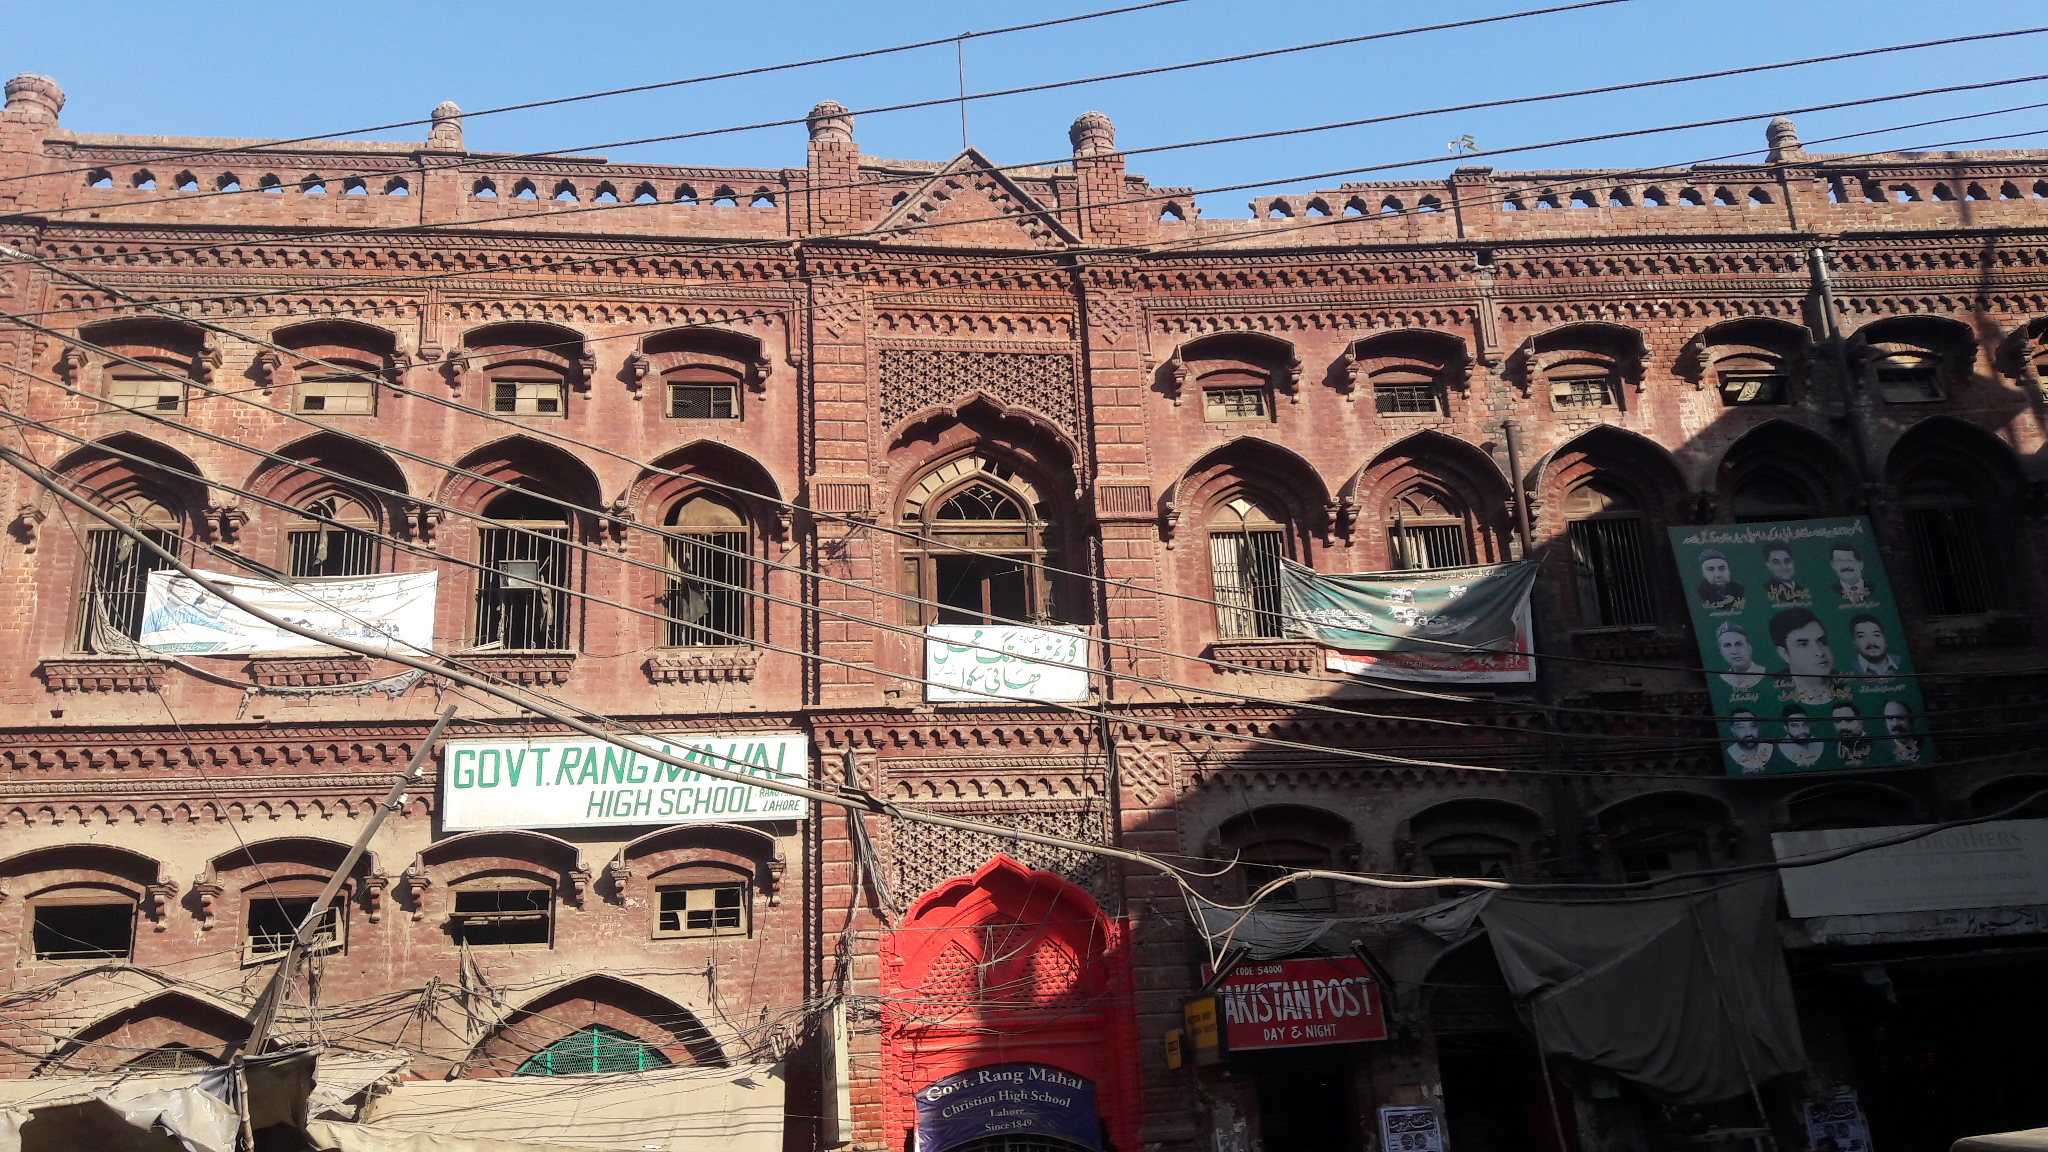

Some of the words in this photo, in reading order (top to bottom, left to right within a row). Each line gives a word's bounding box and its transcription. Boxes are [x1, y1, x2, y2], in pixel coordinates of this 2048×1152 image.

[454, 748, 551, 789] GOVT.
[554, 746, 649, 786] RANG
[653, 741, 794, 784] MAHAL
[586, 790, 651, 819] HIGH
[657, 784, 757, 816] SCHOOL
[762, 799, 802, 812] LAHORE
[1235, 967, 1254, 976] CODE
[1257, 964, 1283, 975] 54000
[1313, 976, 1373, 1020] POST
[1263, 1026, 1285, 1041] DAY
[1290, 1025, 1303, 1040] &
[1305, 1023, 1337, 1038] NIGHT
[925, 1077, 974, 1102] Govt.
[977, 1069, 1024, 1085] Rang
[1028, 1066, 1084, 1091] Mahal
[942, 1093, 996, 1119] Christian
[998, 1089, 1028, 1103] High
[1030, 1089, 1072, 1109] School
[989, 1107, 1025, 1118] Lahore
[985, 1121, 1010, 1132] Since
[1011, 1118, 1033, 1129] 1849
